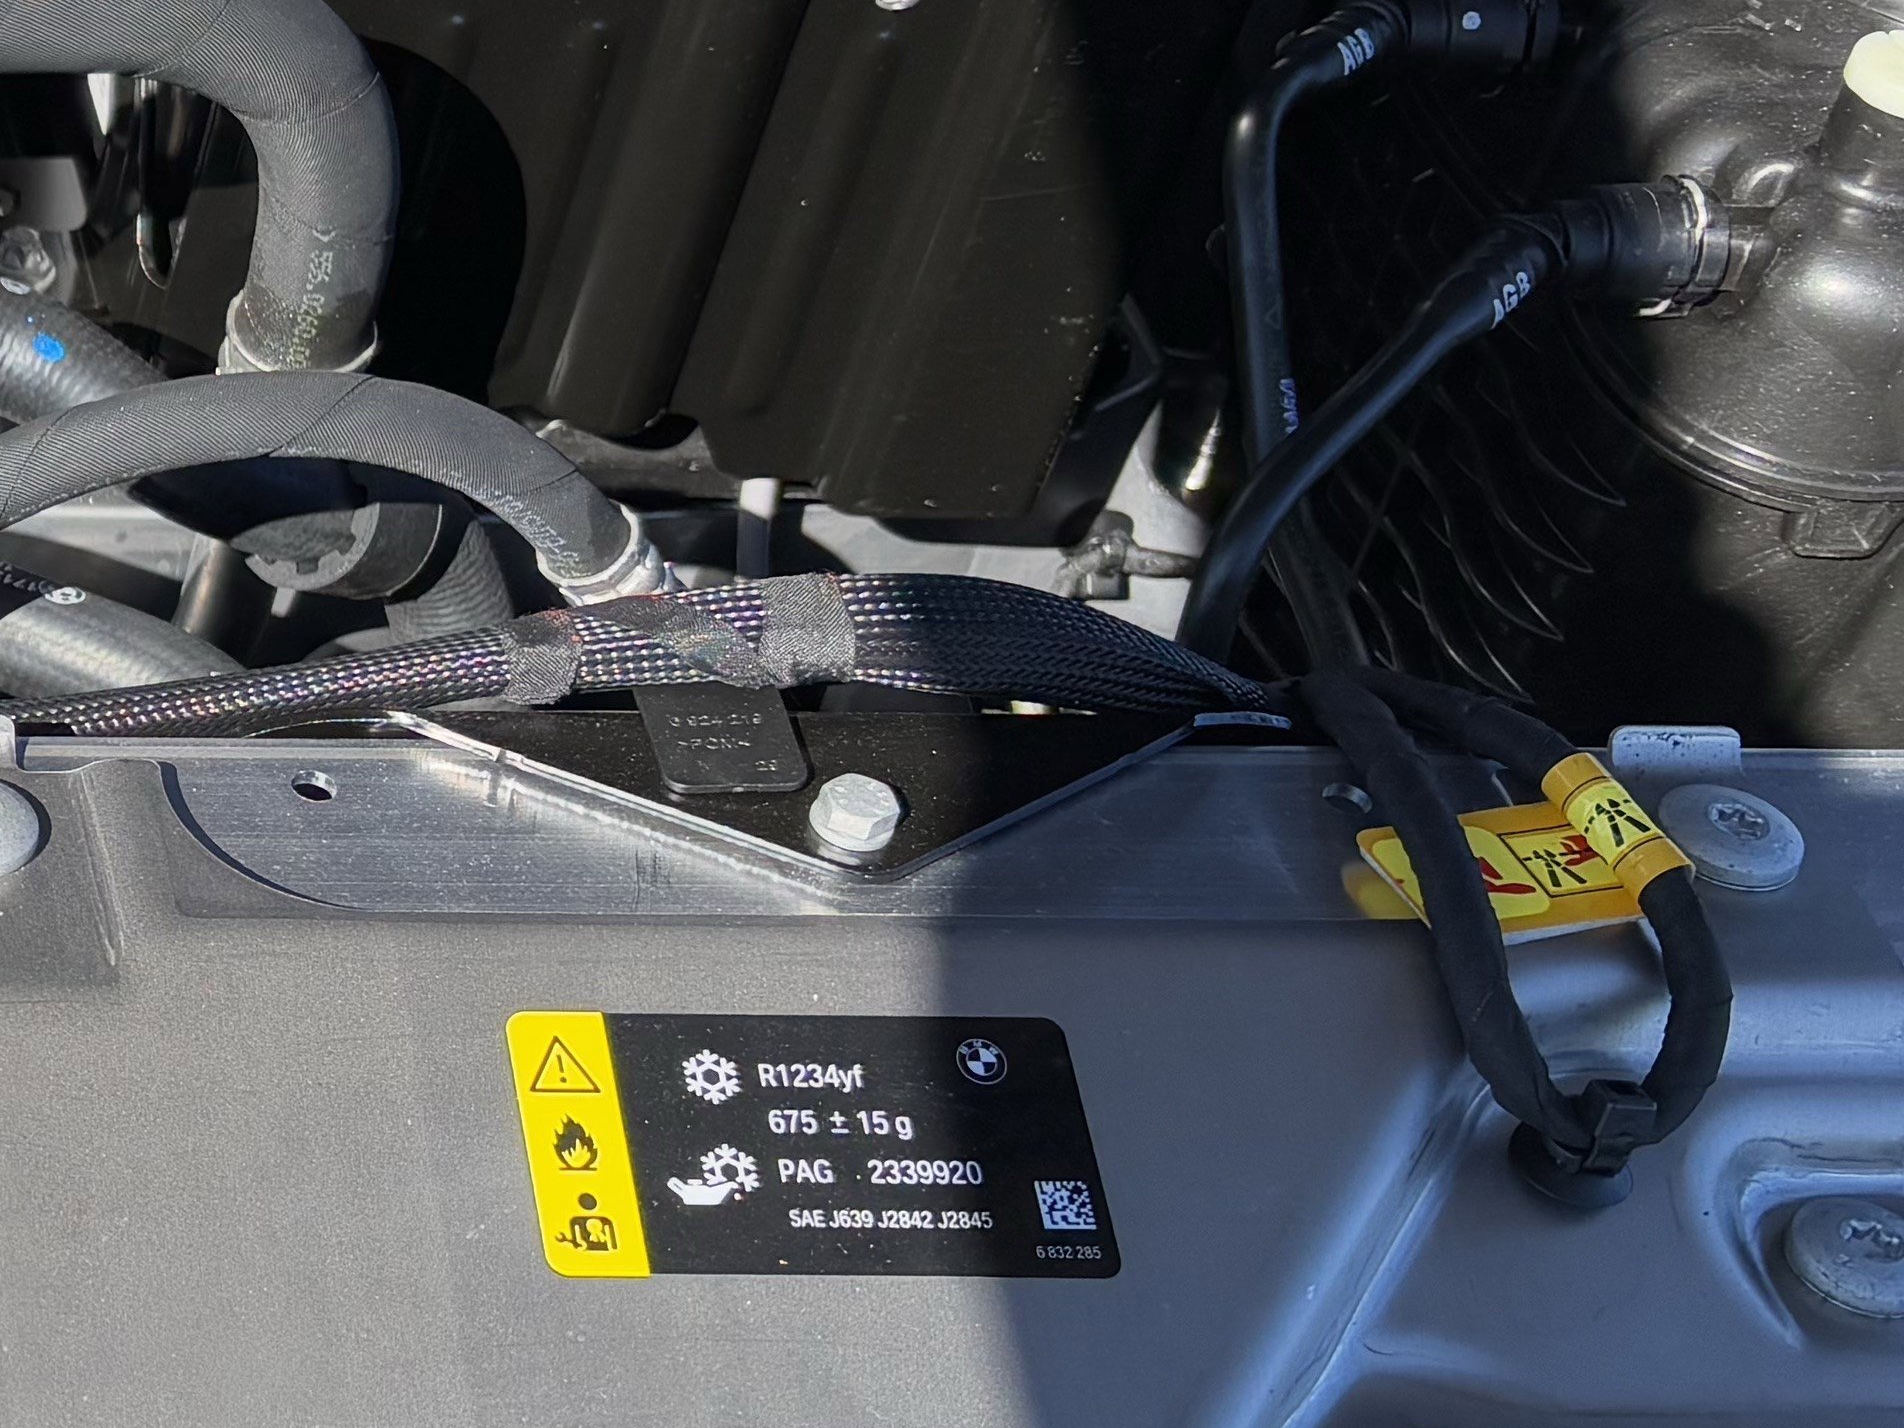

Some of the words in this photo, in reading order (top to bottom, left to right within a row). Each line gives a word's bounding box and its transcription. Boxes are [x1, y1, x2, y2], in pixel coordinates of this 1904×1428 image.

[1490, 271, 1533, 330] AGB
[758, 1062, 865, 1094] R1234yf
[768, 1109, 818, 1135] 675
[856, 1110, 890, 1135] 15
[895, 1115, 914, 1140] g
[778, 1158, 835, 1184] PAG
[867, 1159, 984, 1186] 2339920
[788, 1209, 826, 1228] SAE
[829, 1209, 874, 1229] J639
[877, 1209, 933, 1229] J2842
[937, 1210, 993, 1230] J2845
[1036, 1246, 1046, 1260] 6
[1047, 1246, 1074, 1260] 832
[1075, 1246, 1102, 1260] 285
